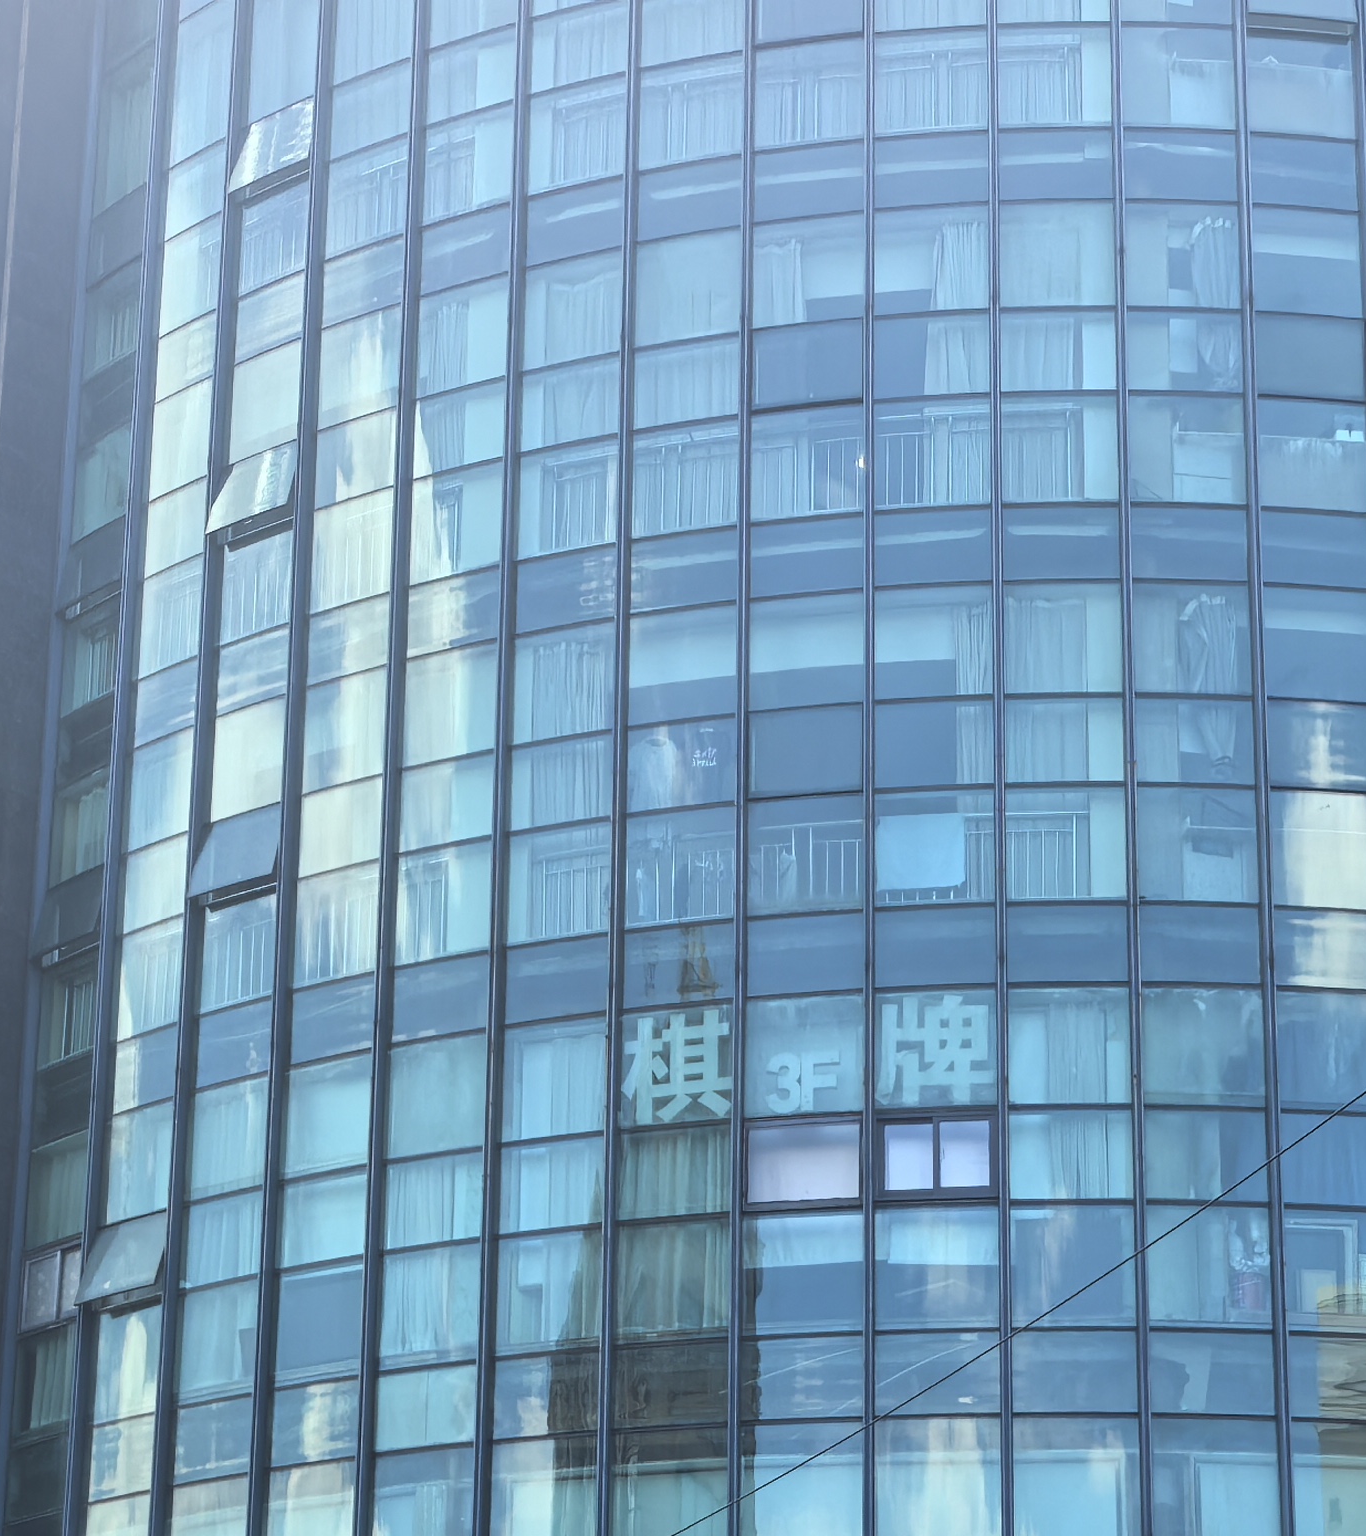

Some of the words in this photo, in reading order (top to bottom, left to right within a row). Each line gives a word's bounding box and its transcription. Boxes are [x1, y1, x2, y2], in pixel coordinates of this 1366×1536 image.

[621, 1009, 732, 1125] 棋
[765, 1052, 841, 1115] 3F
[875, 995, 994, 1107] 牌
